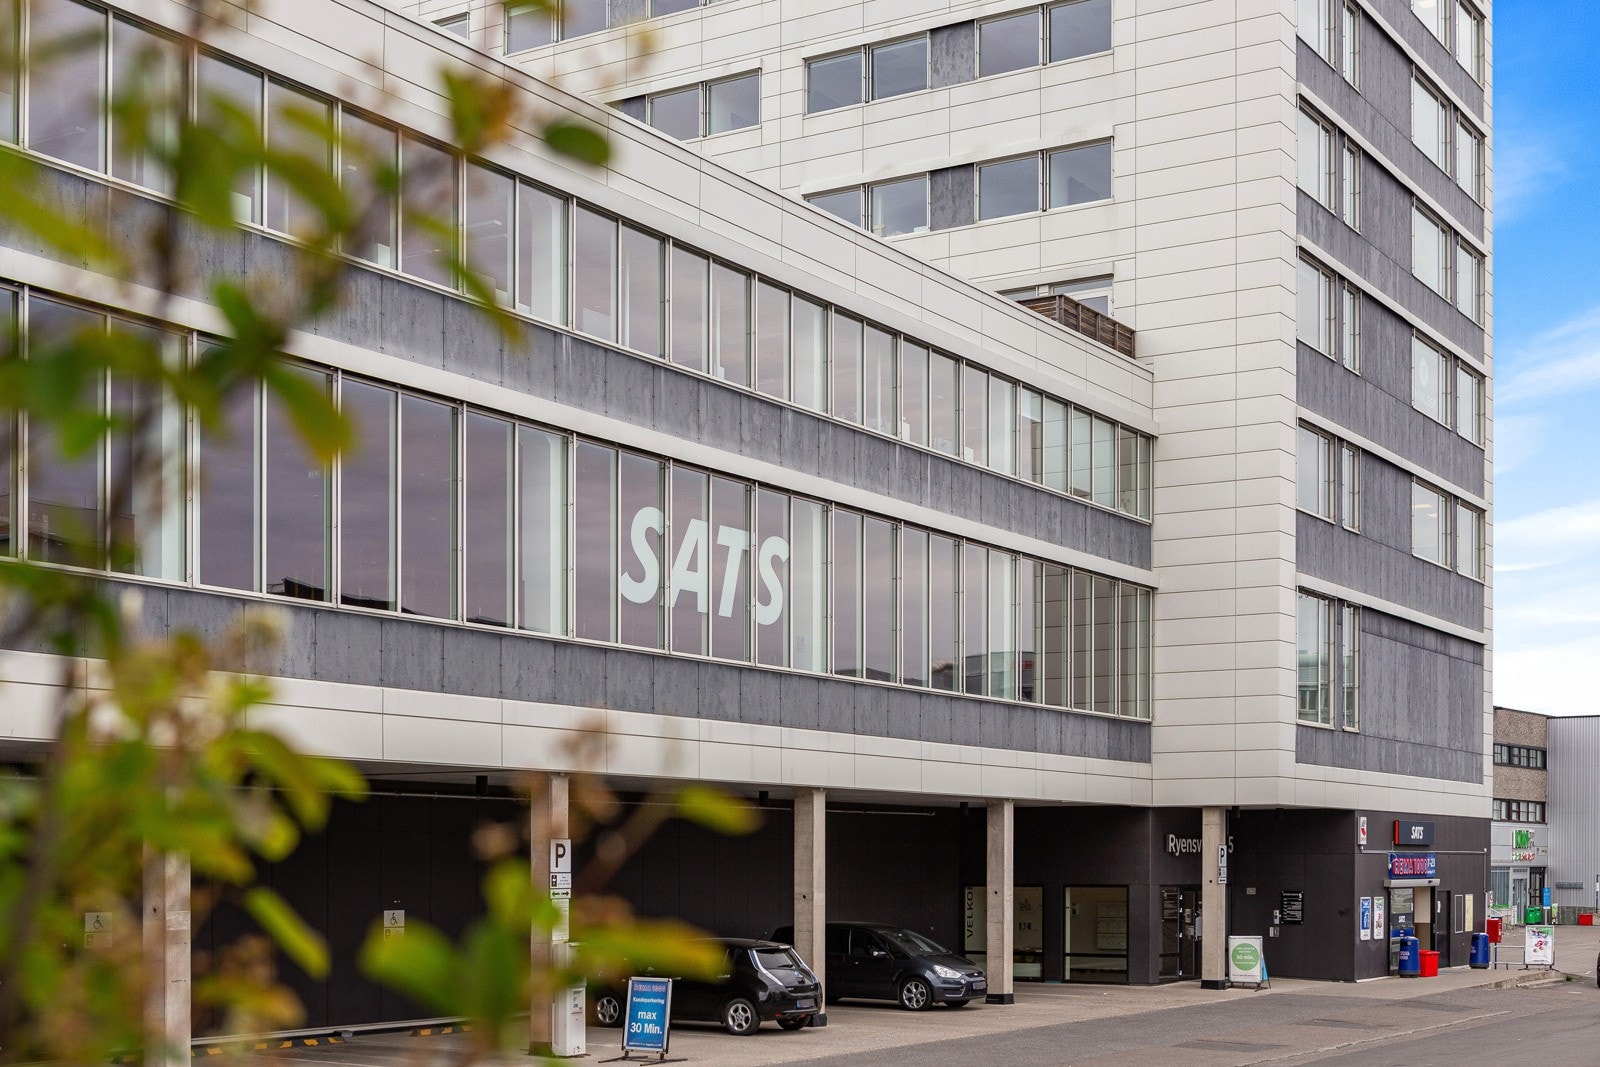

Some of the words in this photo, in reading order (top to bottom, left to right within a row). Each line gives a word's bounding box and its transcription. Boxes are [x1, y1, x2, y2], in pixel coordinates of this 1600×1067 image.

[621, 506, 790, 626] SATS
[1411, 826, 1424, 839] SATS
[555, 843, 566, 868] P
[1168, 834, 1203, 856] Ryensv
[1228, 836, 1234, 854] 5
[966, 887, 974, 939] VELKO
[637, 1011, 657, 1020] max
[630, 1022, 642, 1033] 30
[644, 1023, 663, 1035] Min.
